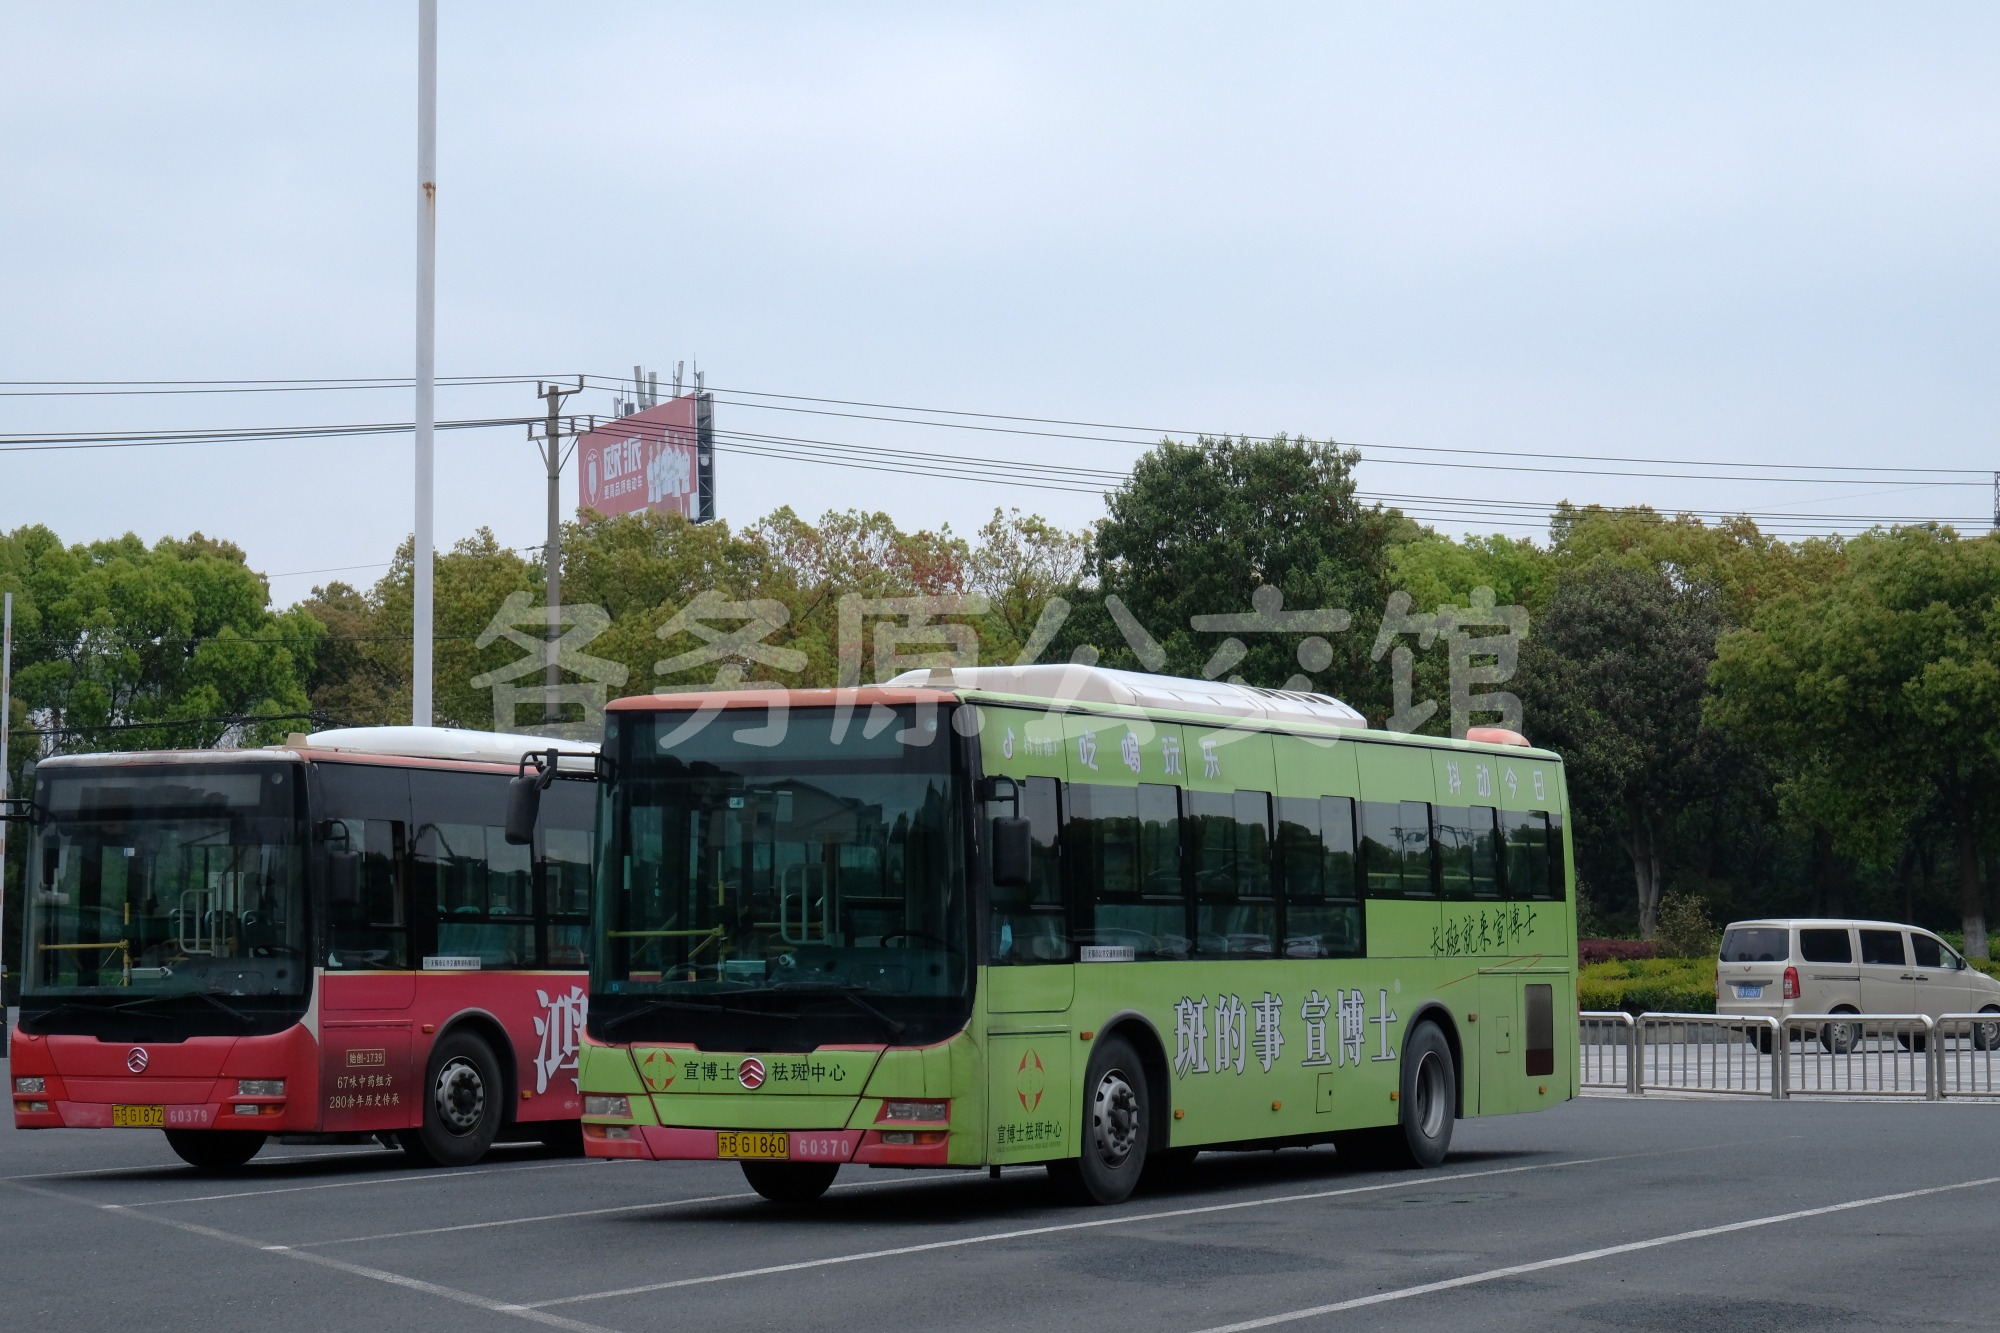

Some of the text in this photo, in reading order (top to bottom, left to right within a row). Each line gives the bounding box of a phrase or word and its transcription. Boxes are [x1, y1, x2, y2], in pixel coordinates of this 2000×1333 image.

[604, 434, 641, 481] 欧派
[684, 1061, 846, 1082] 宣博士 祛斑中心
[337, 1074, 392, 1089] 67味中药组方
[329, 1093, 400, 1109] 280余年历史传承
[170, 1109, 207, 1123] 60379
[997, 1120, 1061, 1144] 宣博士祛斑中心
[799, 1139, 849, 1156] 60370
